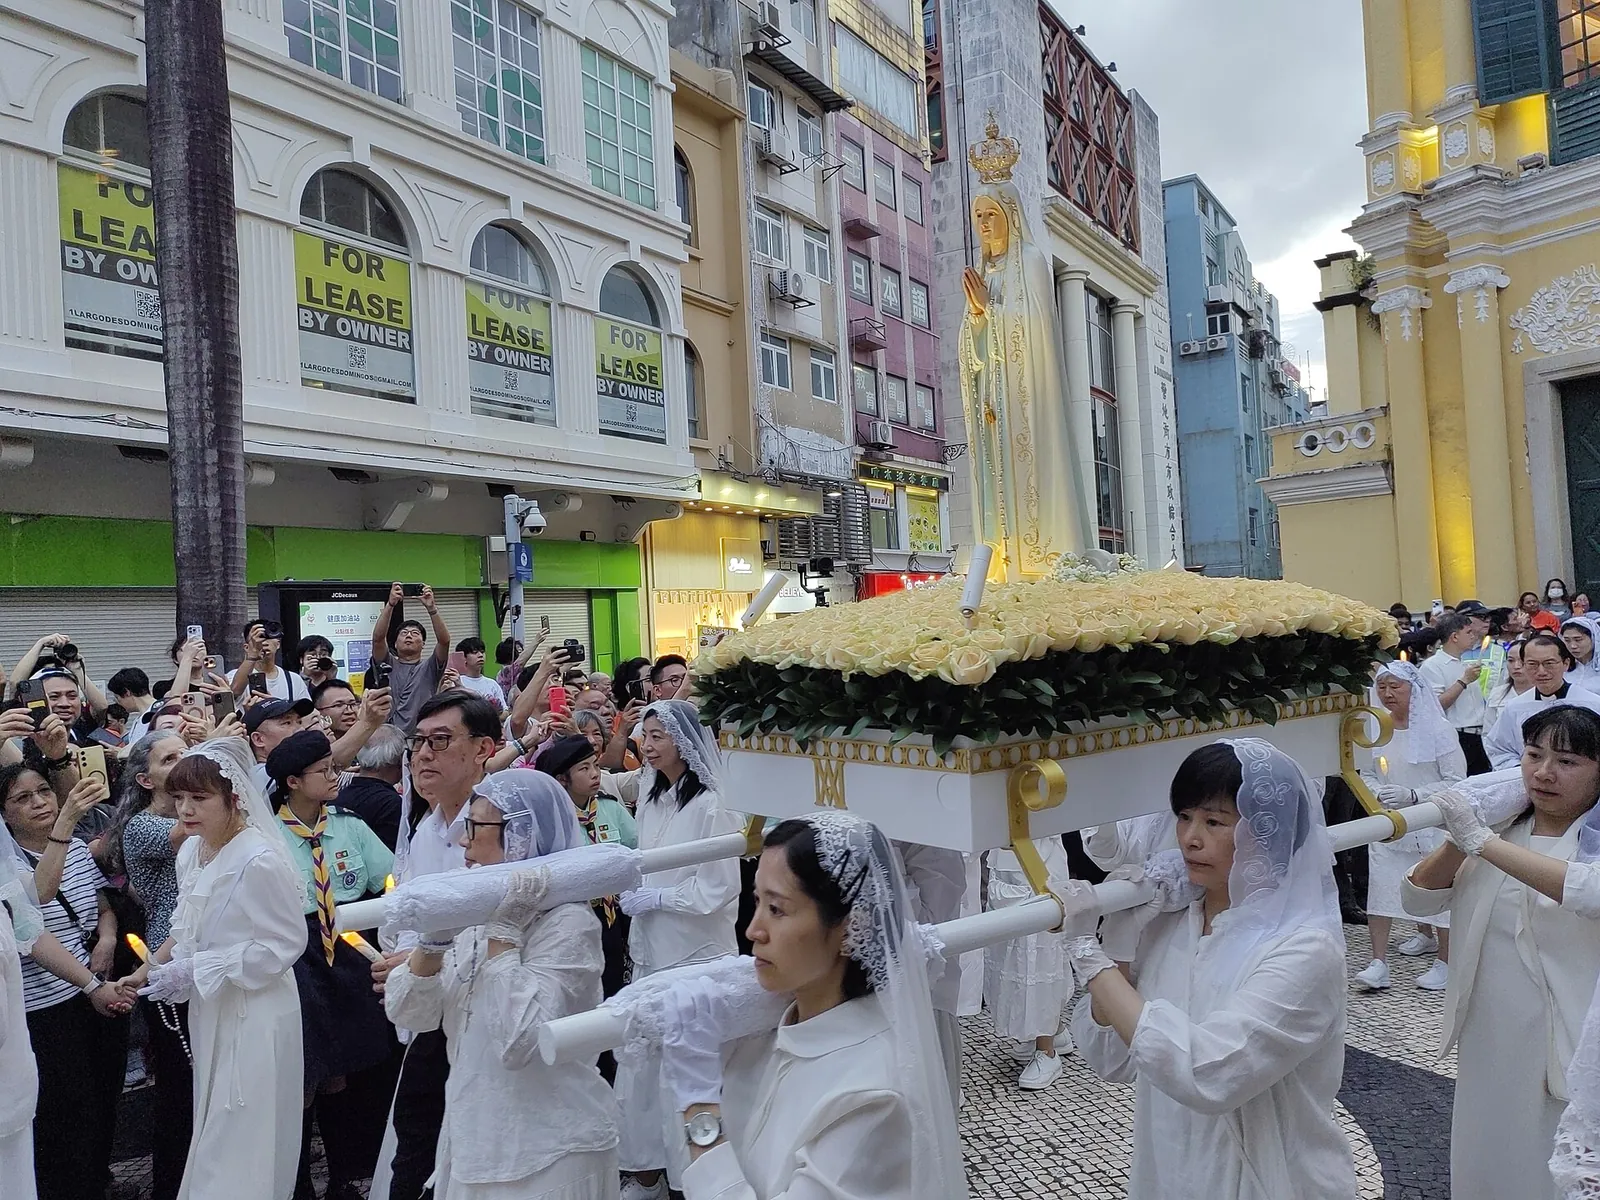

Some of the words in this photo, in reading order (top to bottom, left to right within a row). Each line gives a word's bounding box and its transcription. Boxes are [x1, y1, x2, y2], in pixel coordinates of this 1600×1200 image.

[98, 181, 153, 208] FO
[73, 208, 156, 256] LEA
[65, 246, 106, 273] BY
[324, 240, 386, 281] FOR
[305, 276, 404, 325] LEASE
[484, 285, 531, 315] FOR
[299, 306, 330, 331] BY
[336, 317, 411, 350] OWNER
[470, 314, 545, 351] LEASE
[610, 325, 648, 352] FOR
[468, 340, 488, 358] BY
[494, 347, 550, 372] OWNER
[600, 353, 659, 385] LEASE
[597, 378, 615, 394] BY
[618, 384, 664, 404] OWNER
